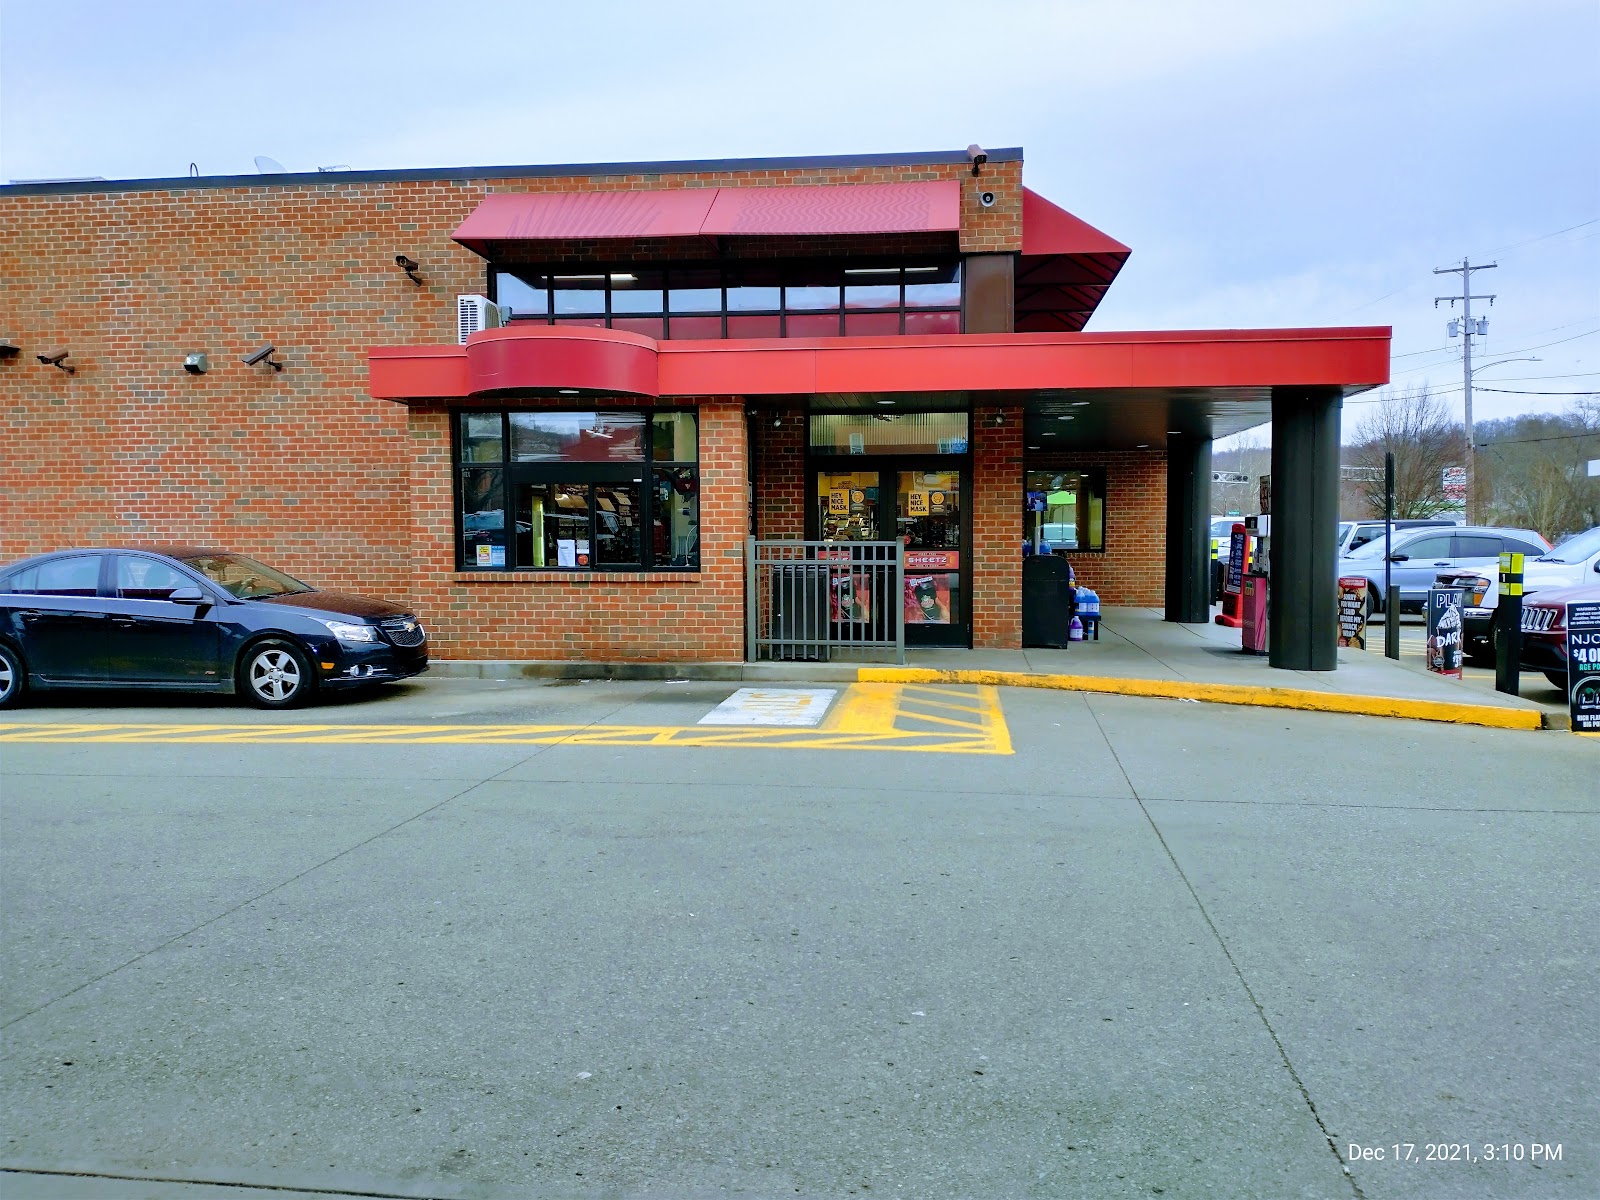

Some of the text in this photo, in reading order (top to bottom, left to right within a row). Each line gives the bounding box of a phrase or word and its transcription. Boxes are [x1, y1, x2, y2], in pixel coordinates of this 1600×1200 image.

[1436, 593, 1463, 608] PLAY
[1436, 631, 1462, 648] DARK
[1573, 648, 1587, 663] $4
[1579, 663, 1591, 671] AGE
